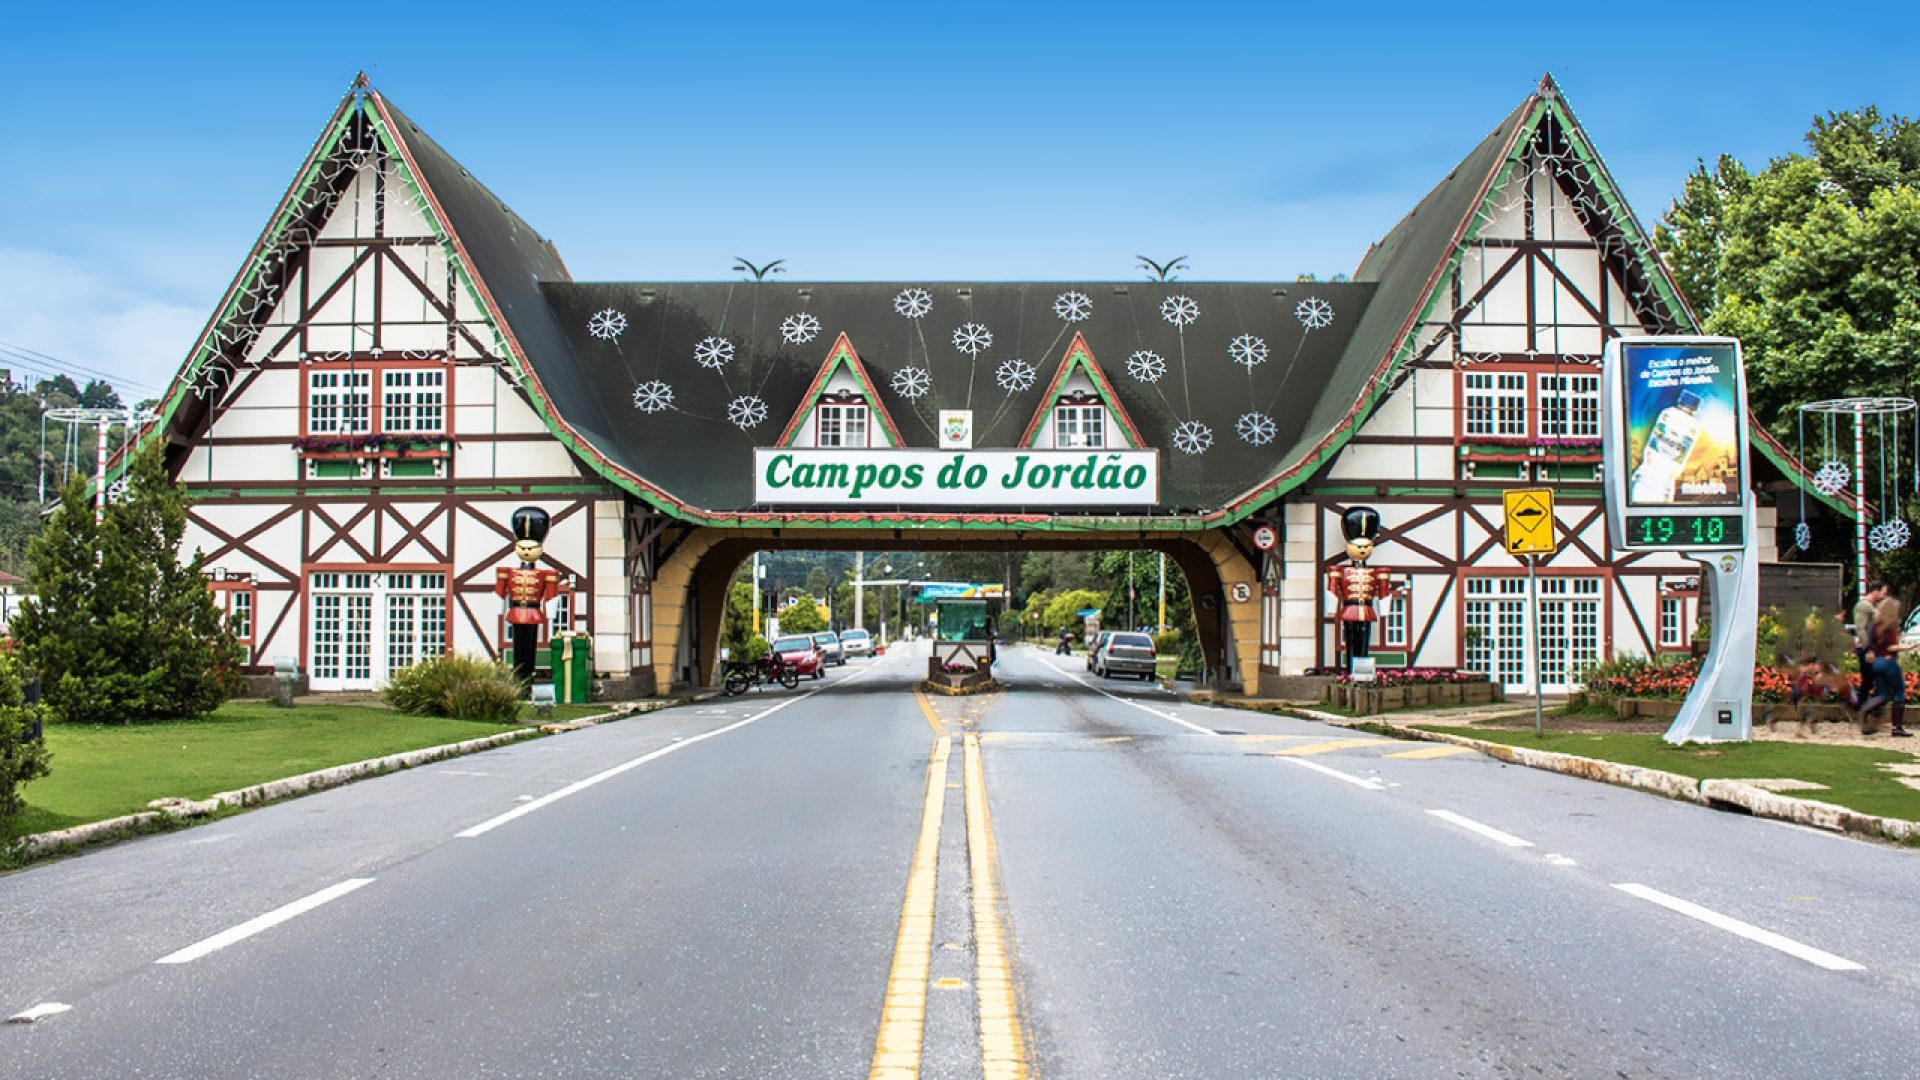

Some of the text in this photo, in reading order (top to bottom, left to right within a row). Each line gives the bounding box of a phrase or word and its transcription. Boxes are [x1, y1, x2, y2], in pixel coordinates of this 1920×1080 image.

[1648, 358, 1677, 368] Escolha
[1685, 356, 1713, 365] melhor
[1640, 370, 1650, 378] de
[1652, 368, 1680, 379] Campos
[1682, 367, 1692, 375] do
[766, 454, 1147, 498] Campos do Jordão
[1640, 517, 1724, 543] 19 10
